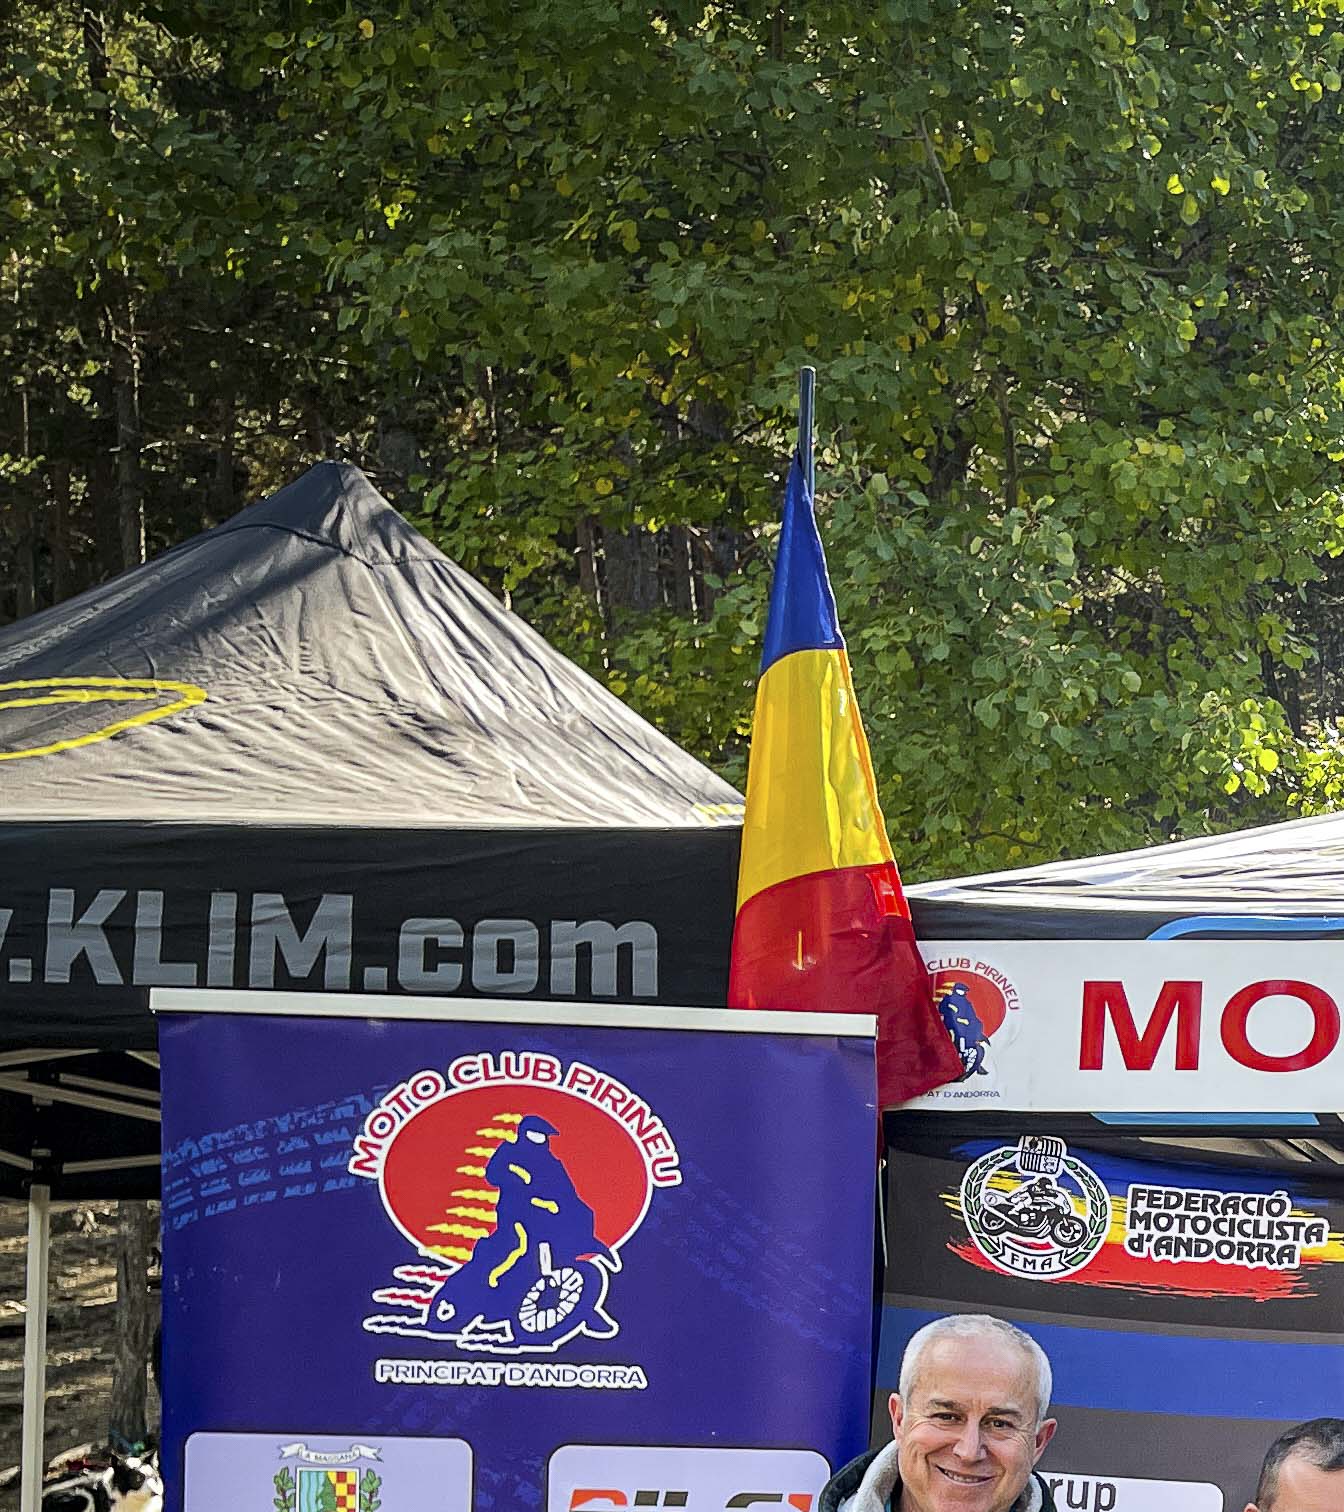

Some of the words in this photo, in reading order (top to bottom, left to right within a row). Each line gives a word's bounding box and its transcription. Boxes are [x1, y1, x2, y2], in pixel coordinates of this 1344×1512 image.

[0, 887, 659, 998] .KLIM.com
[926, 958, 971, 972] CLUB
[974, 961, 1021, 1011] PIRINEU
[352, 1070, 442, 1176] MOTO
[452, 1055, 560, 1085] CLUB
[566, 1063, 681, 1186] PIRINEU
[1129, 1190, 1288, 1218] FEDERACIÓ
[1128, 1210, 1328, 1245] MOTOCICLISTA
[1010, 1252, 1054, 1273] FMA
[1127, 1232, 1298, 1265] d'ANDORRA
[379, 1361, 503, 1385] PRINCIPAT
[508, 1364, 644, 1388] D'ANDORRA
